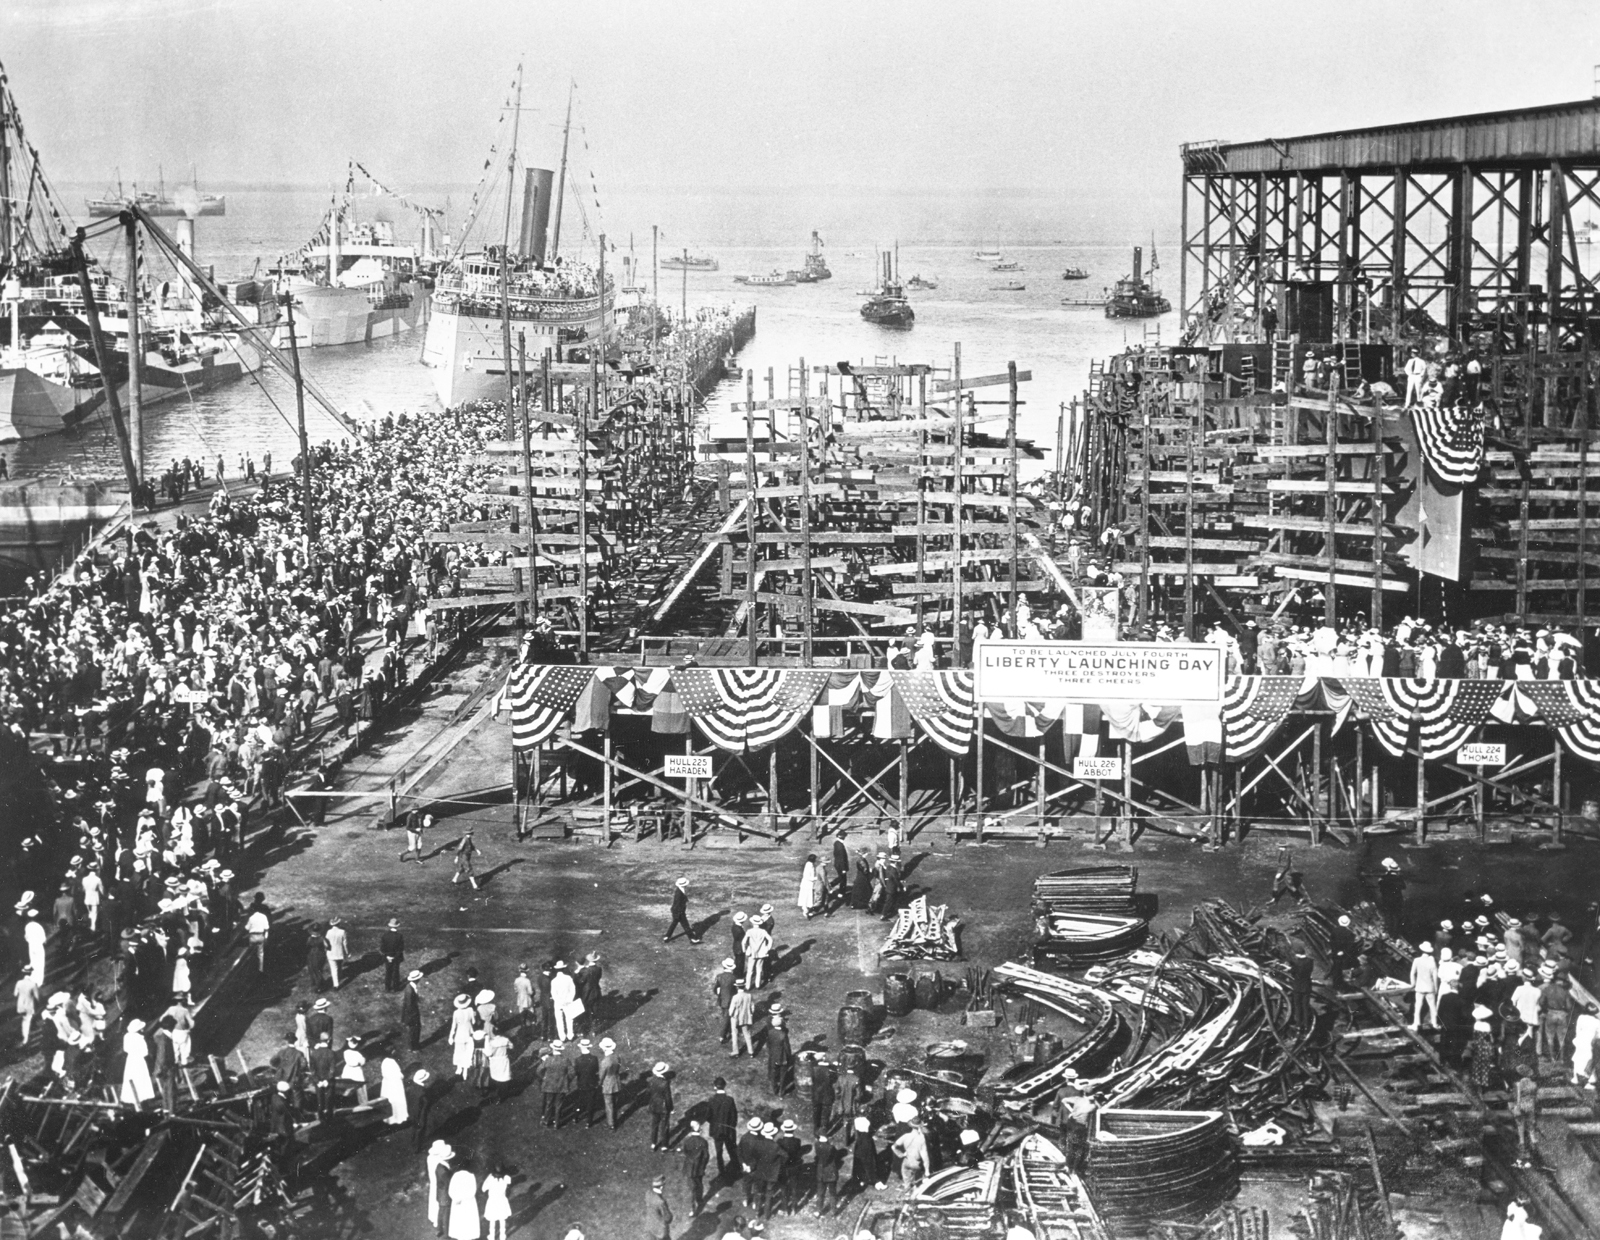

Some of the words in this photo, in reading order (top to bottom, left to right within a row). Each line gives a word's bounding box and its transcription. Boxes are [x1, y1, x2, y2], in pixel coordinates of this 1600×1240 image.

[1048, 649, 1107, 657] LAUNCHED
[986, 656, 1060, 668] LIBERTY
[1068, 658, 1170, 670] LAUNCHING
[1178, 659, 1213, 671] DAY
[1462, 745, 1483, 753] HULL
[1485, 745, 1501, 753] 224
[669, 758, 691, 766] HULL
[692, 758, 708, 766] 225
[1463, 754, 1500, 762] THOMAS
[1078, 760, 1098, 768] HULL
[1100, 760, 1116, 768] 226
[669, 766, 708, 775] HARADEN
[1084, 768, 1112, 776] ABBOT
